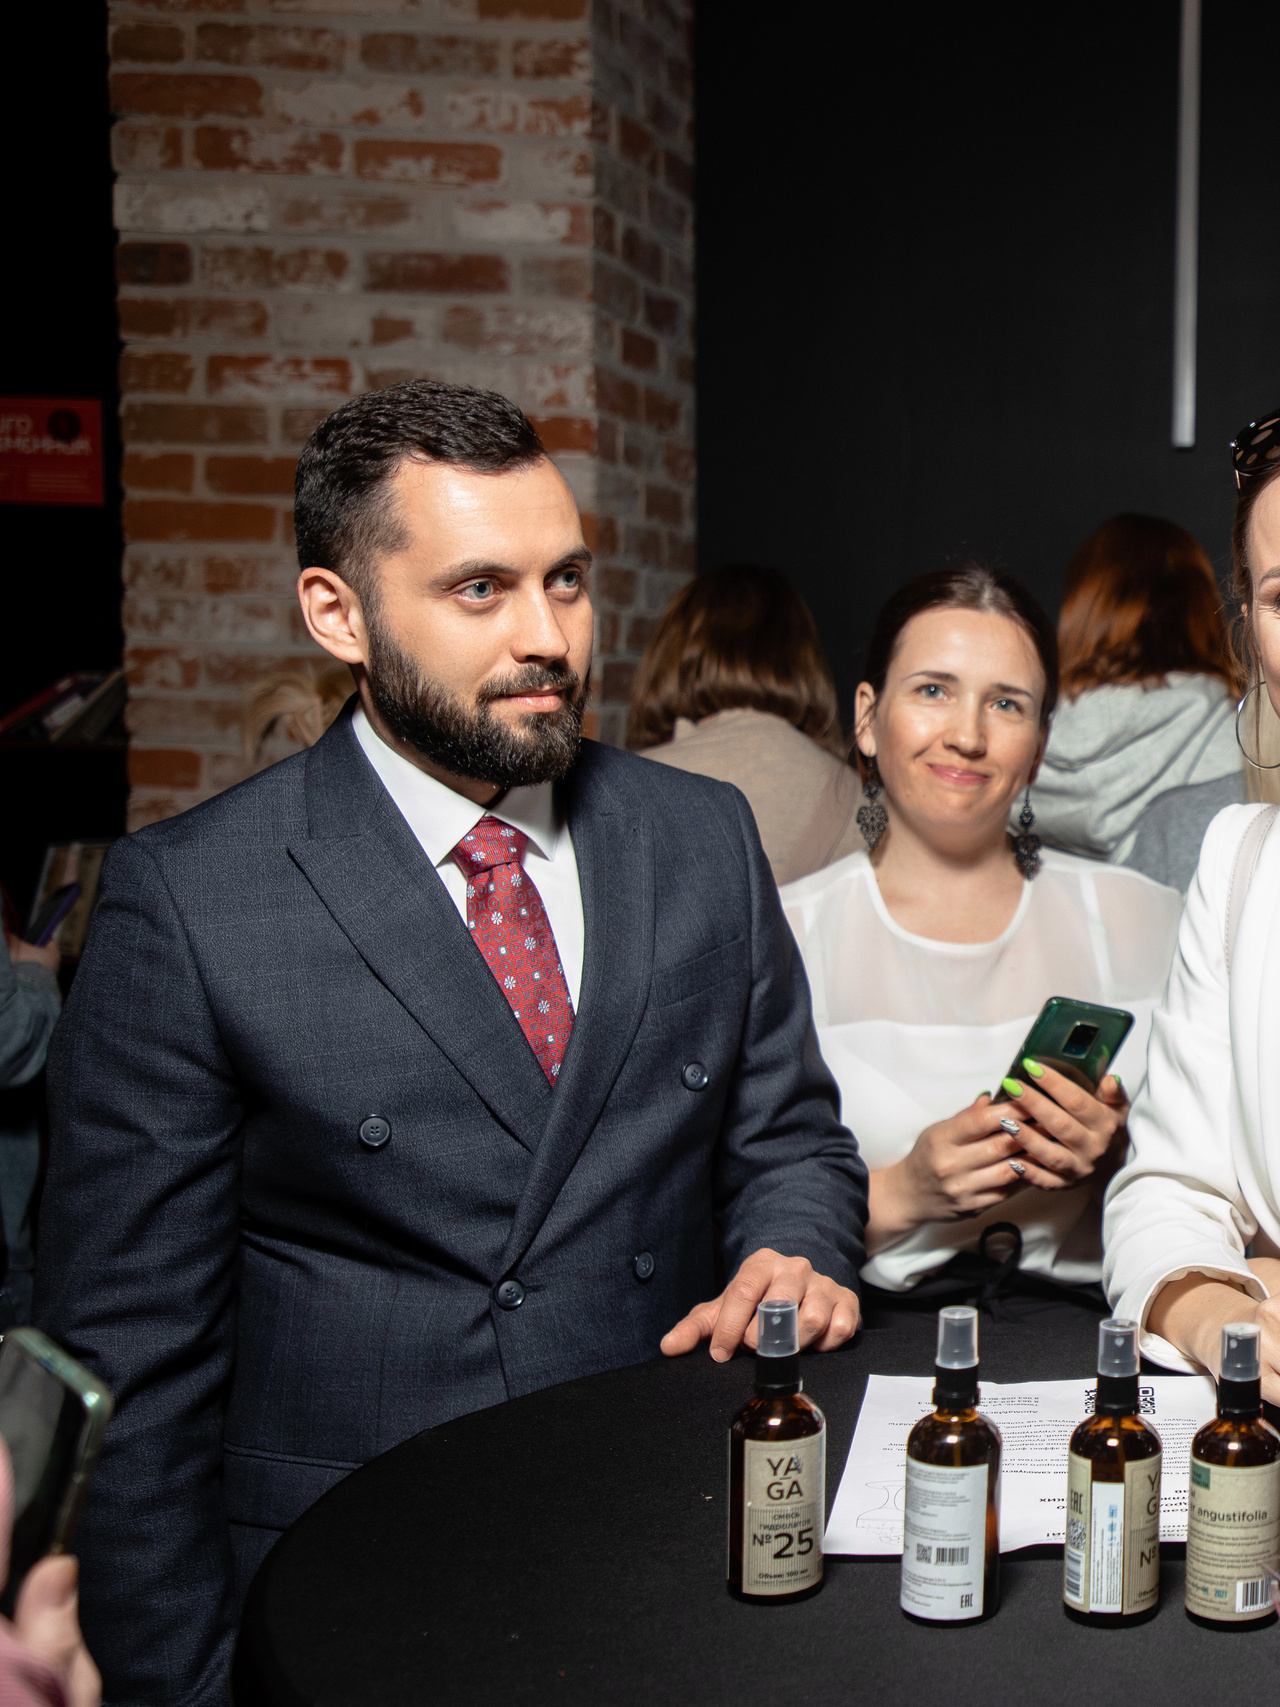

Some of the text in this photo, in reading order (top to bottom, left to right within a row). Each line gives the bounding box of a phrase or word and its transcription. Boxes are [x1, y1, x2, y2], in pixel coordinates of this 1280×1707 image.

[766, 1456, 804, 1477] YA
[766, 1480, 804, 1501] GA
[1070, 1488, 1084, 1515] EAC
[1197, 1507, 1269, 1523] angustifolia
